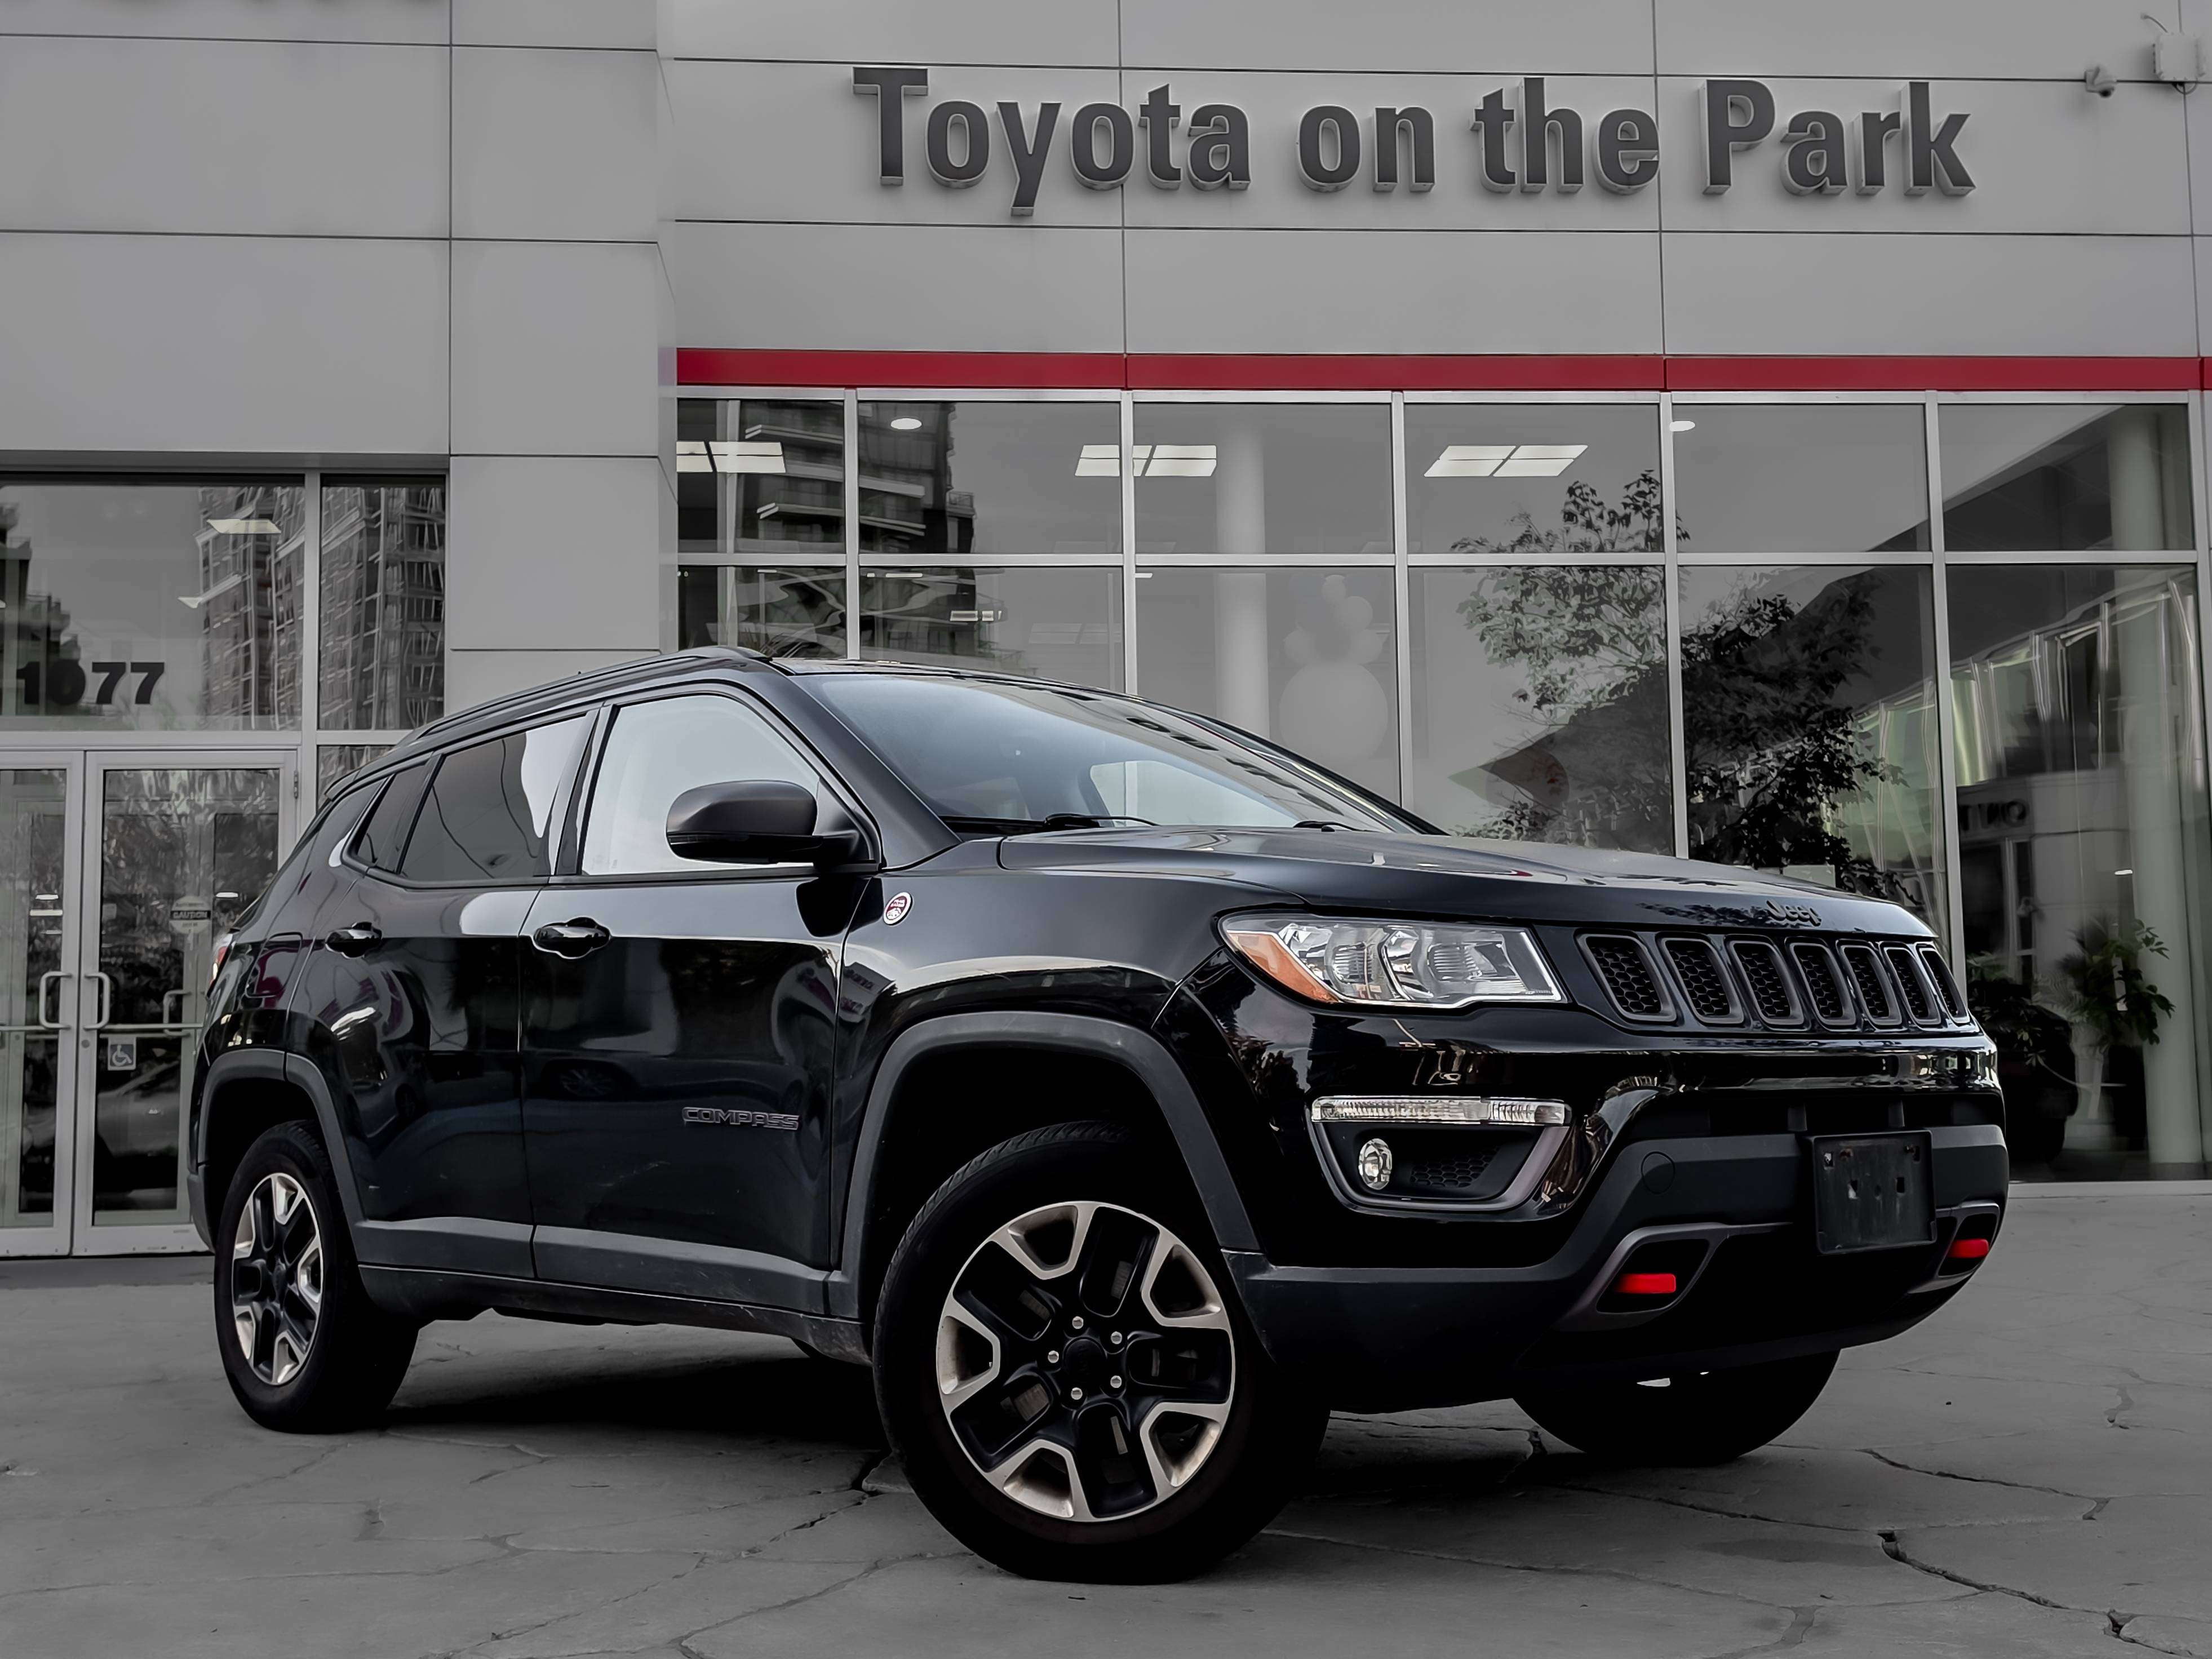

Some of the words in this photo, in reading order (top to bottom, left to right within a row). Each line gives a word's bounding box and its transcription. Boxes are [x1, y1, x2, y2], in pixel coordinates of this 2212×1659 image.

[853, 66, 1251, 215] Toyota
[1298, 105, 1435, 192] on
[1470, 77, 1660, 194] the
[1699, 79, 1976, 195] Park
[16, 661, 165, 704] 1077
[1766, 900, 1821, 926] Jeep
[682, 1107, 799, 1130] COMPASS
